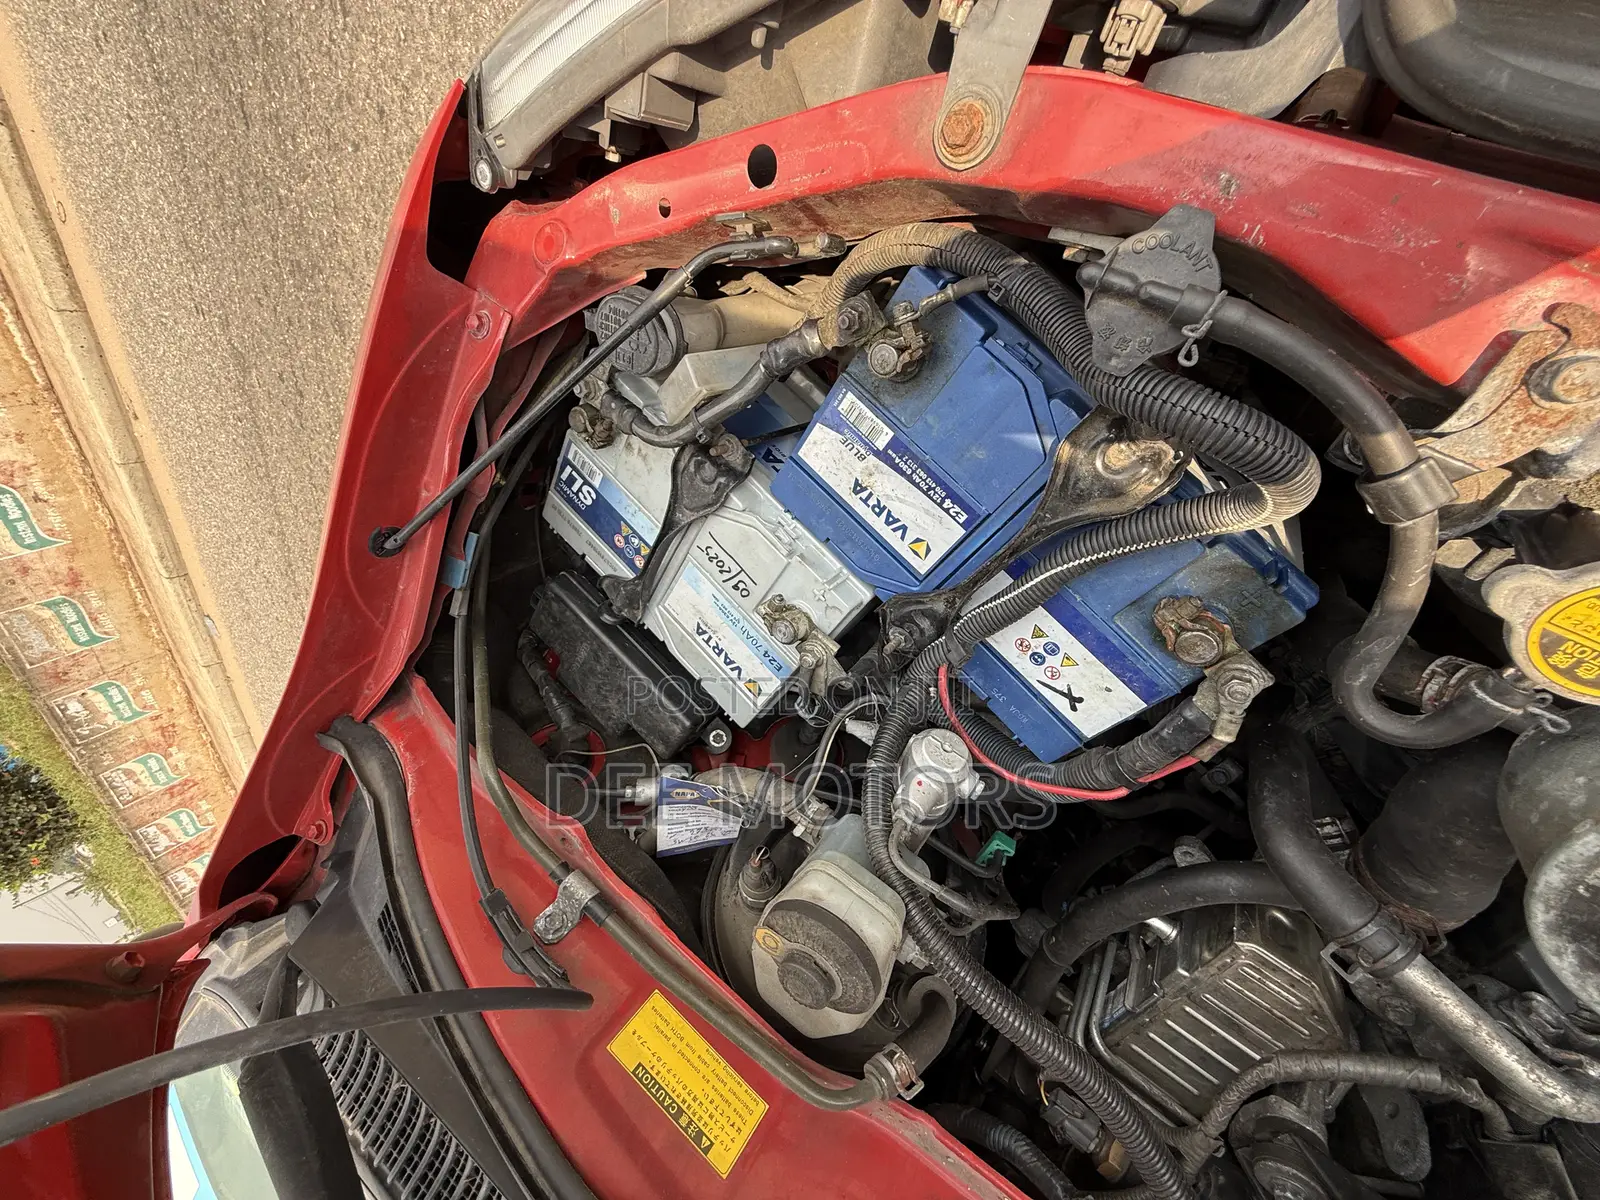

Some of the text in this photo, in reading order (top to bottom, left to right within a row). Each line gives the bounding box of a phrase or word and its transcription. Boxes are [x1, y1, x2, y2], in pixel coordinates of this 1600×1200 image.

[1132, 233, 1213, 272] COOLANT
[838, 435, 867, 463] BLUE
[906, 458, 918, 470] 313
[557, 479, 586, 510] DYNAMIC
[560, 465, 597, 507] SLI
[910, 472, 929, 491] 70Ah
[925, 476, 937, 488] 413
[927, 488, 943, 503] 12V
[848, 476, 908, 542] VARTA
[941, 496, 969, 524] E24
[696, 543, 751, 598] 09/2025
[694, 620, 741, 680] VARTA
[737, 624, 764, 652] 70Ah
[761, 649, 783, 672] E24
[669, 1041, 678, 1049] in
[650, 1004, 754, 1116] Disconnect battery cable from BOTH batteries
[675, 1048, 701, 1074] connected
[701, 1074, 711, 1084] are
[720, 1064, 743, 1089] servicing
[634, 1065, 700, 1138] 注意 CAUTION
[709, 1084, 732, 1108] batteries
[743, 1087, 760, 1106] before
[732, 1107, 748, 1125] These
